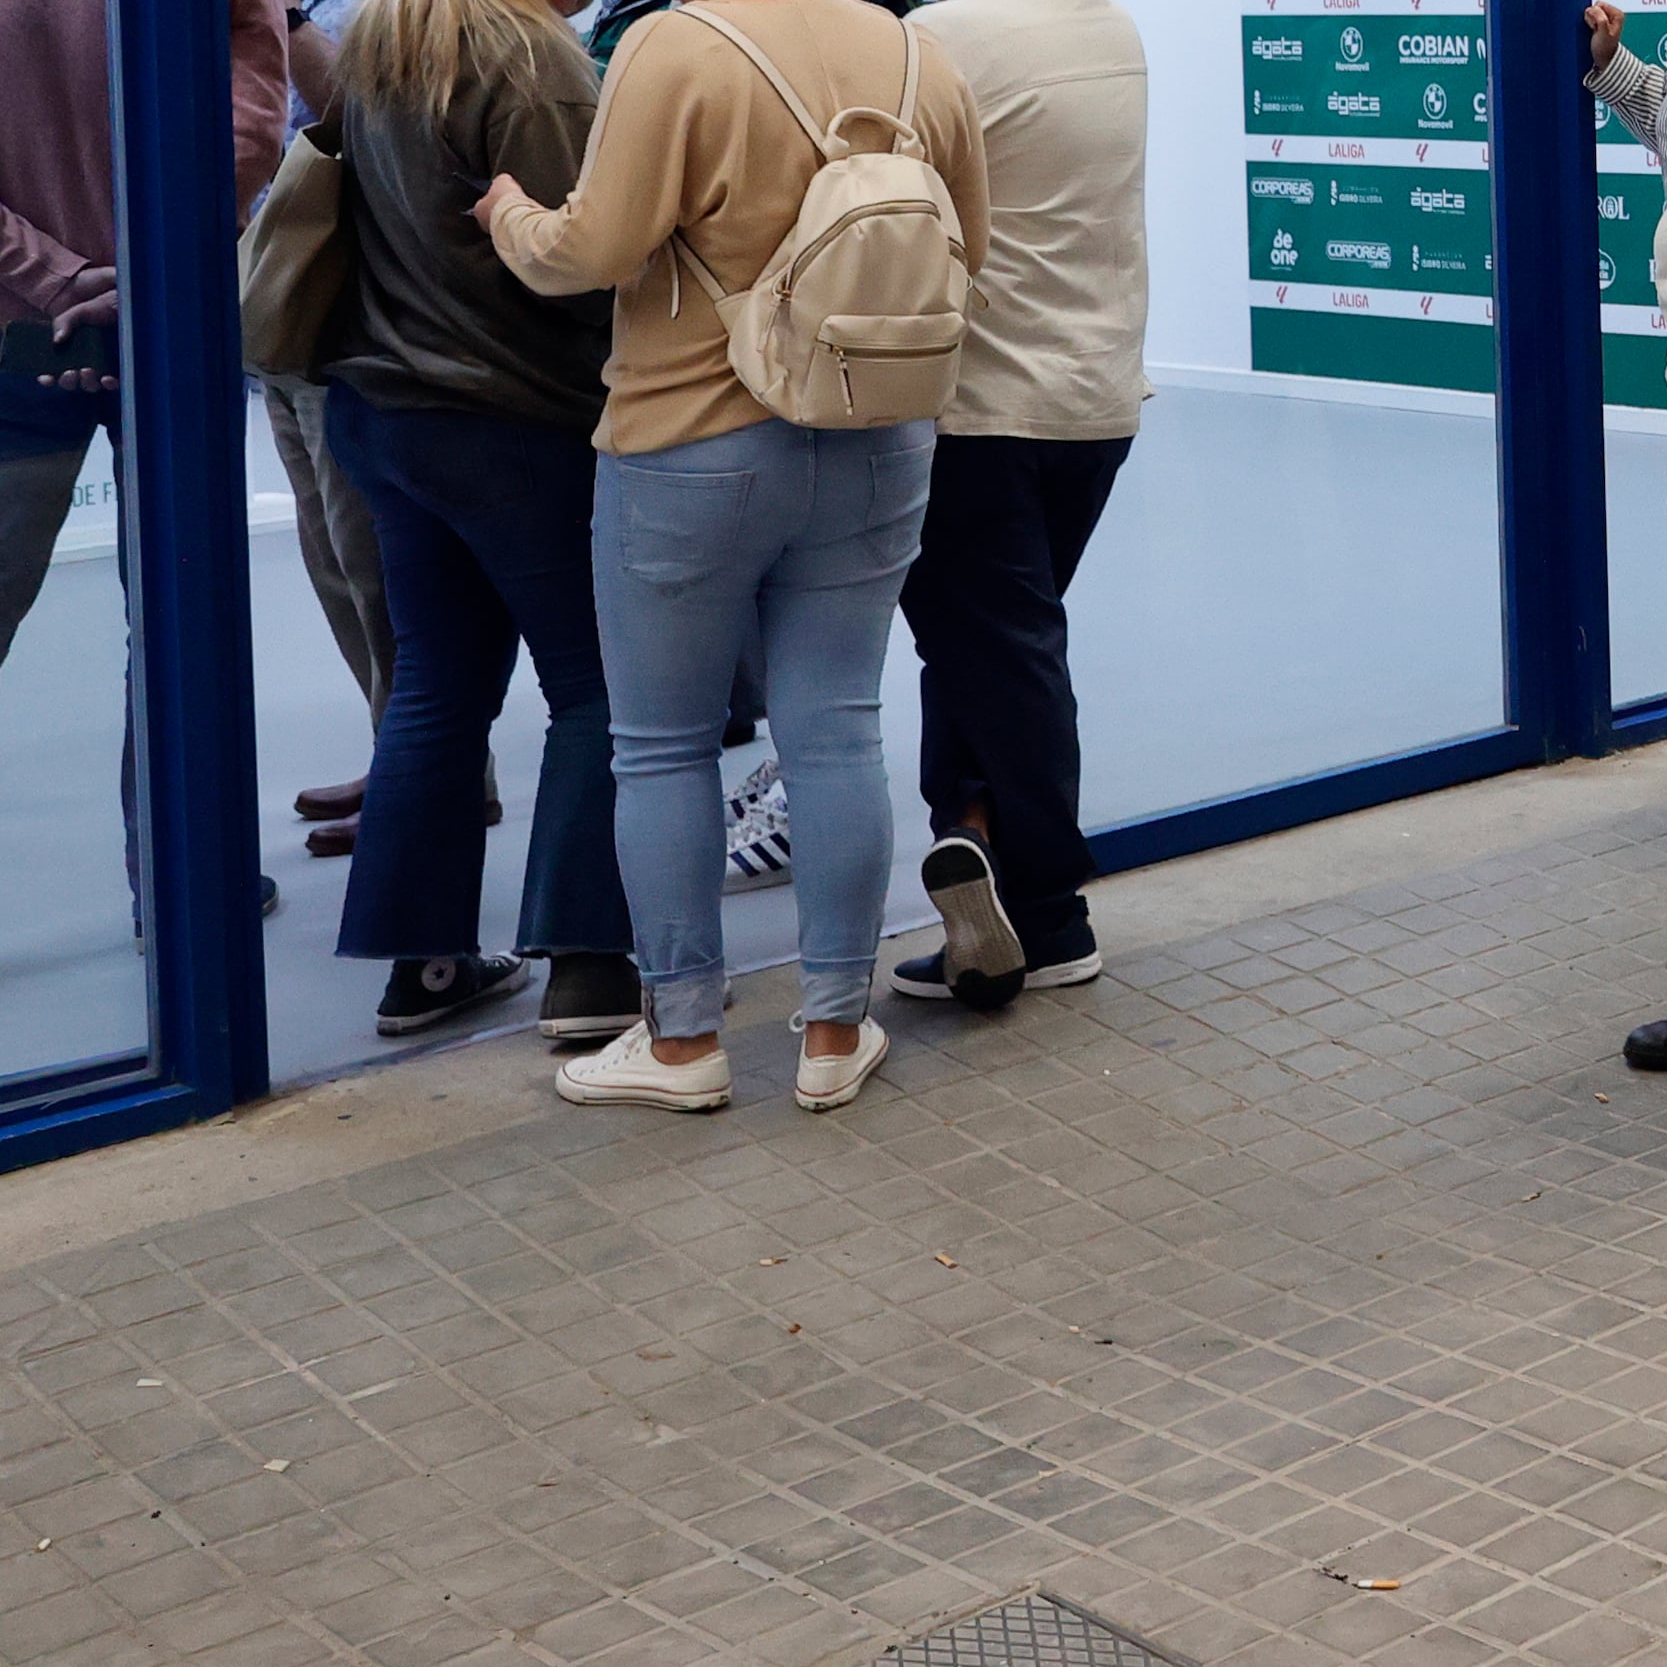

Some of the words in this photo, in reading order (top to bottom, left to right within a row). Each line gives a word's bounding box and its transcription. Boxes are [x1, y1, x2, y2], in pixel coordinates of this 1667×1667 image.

[1398, 35, 1470, 57] COBIAN
[1327, 91, 1381, 116] ágata
[1328, 142, 1365, 159] LALIGA
[1410, 187, 1466, 213] ágata
[1332, 291, 1369, 308] LALIGA
